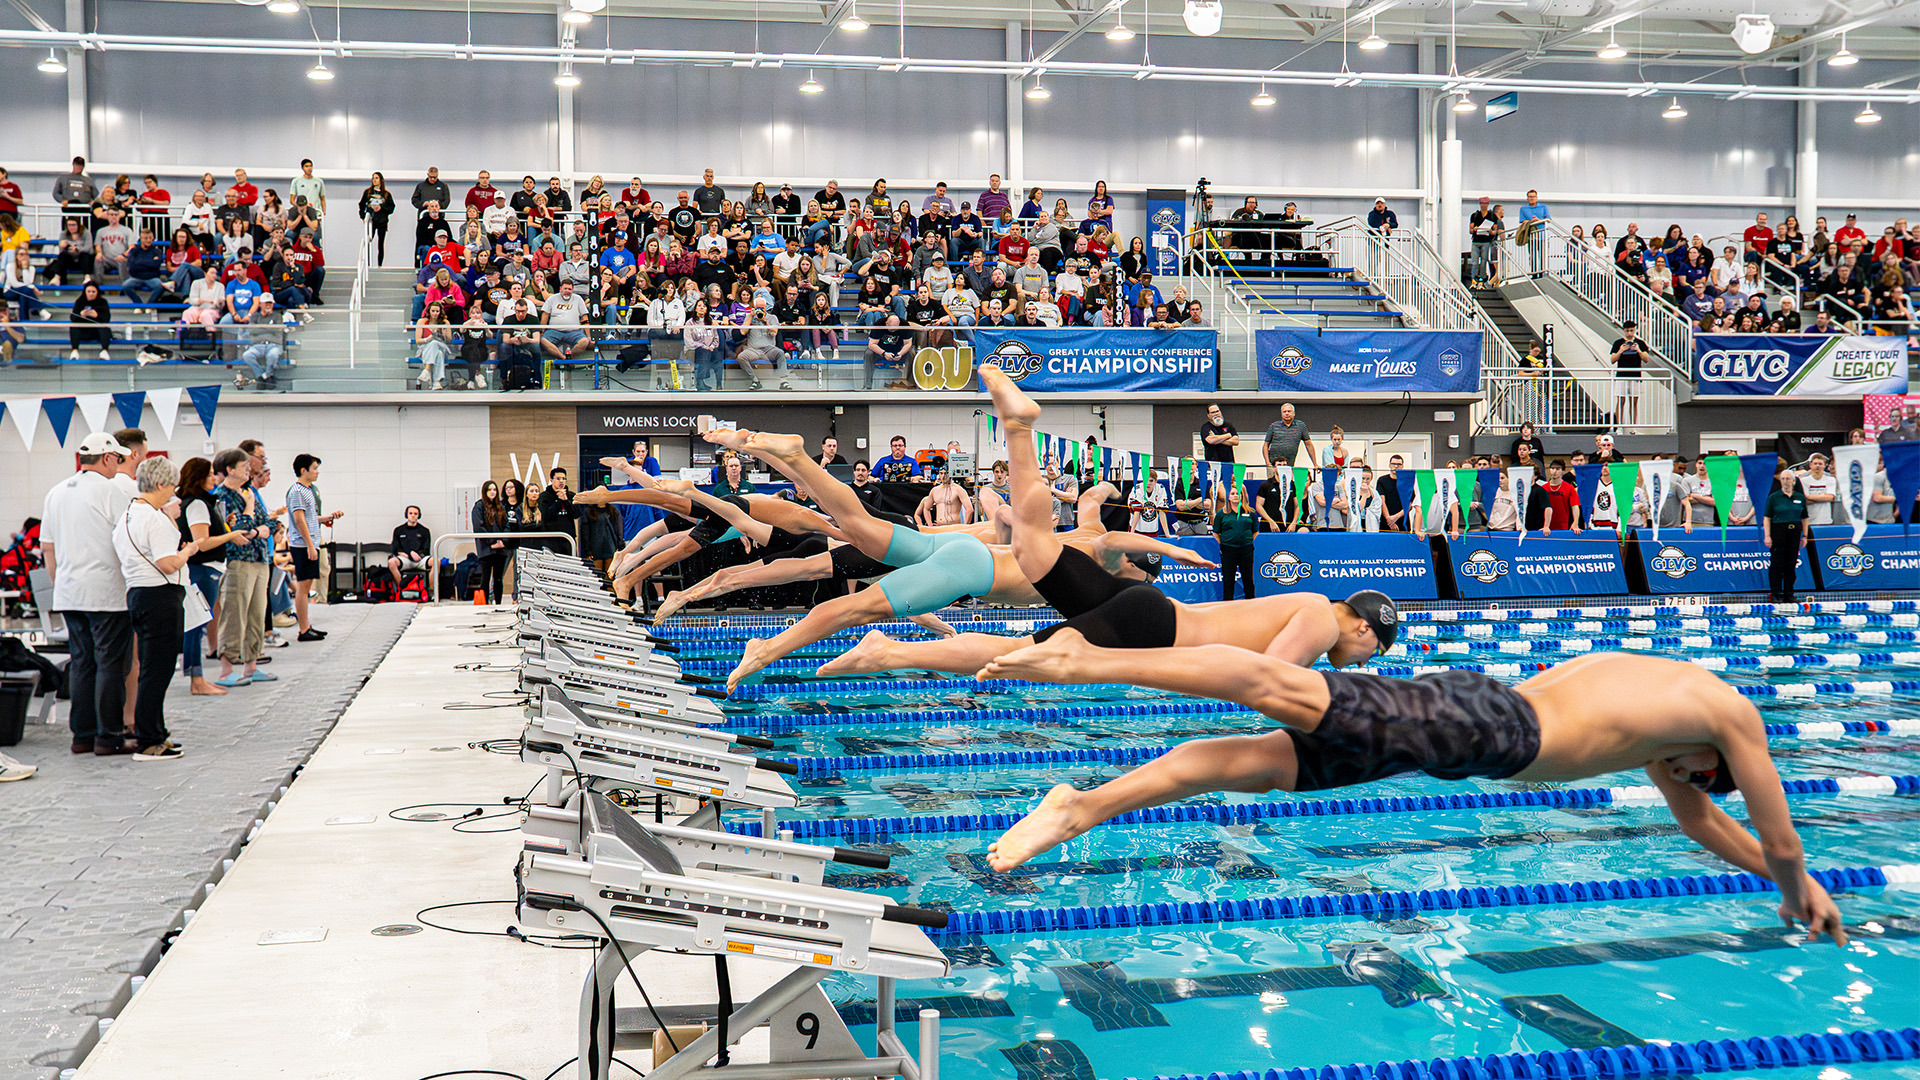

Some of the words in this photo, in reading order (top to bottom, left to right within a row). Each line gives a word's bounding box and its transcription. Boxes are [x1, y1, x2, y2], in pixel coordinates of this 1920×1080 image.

[1048, 348, 1080, 356] GREAT
[1082, 348, 1111, 356] LAKES
[1113, 348, 1149, 356] VALLEY
[1151, 348, 1212, 356] CONFERENCE
[1836, 350, 1872, 360] CREATE
[1874, 350, 1900, 360] YOUR
[913, 346, 973, 391] QU
[984, 354, 1043, 373] GLVC
[1047, 357, 1213, 374] CHAMPIONSHIP
[1271, 355, 1312, 370] GLVC
[1329, 363, 1360, 373] MAKE
[1362, 363, 1373, 373] IT
[1699, 349, 1790, 382] GLVC
[1832, 361, 1897, 379] LEGACY
[603, 416, 660, 427] WOMENS
[663, 416, 697, 427] LOCK
[1800, 436, 1825, 444] DRURY
[509, 453, 561, 491] W
[1461, 560, 1509, 577] GLVC
[1516, 561, 1616, 575] CHAMPIONSHIP
[1651, 556, 1698, 572] GLVC
[1827, 553, 1875, 570] GLVC
[1881, 558, 1920, 569] CHAM
[1260, 562, 1312, 578] GLVC
[1319, 567, 1427, 579] CHAMPIONSHIP
[1669, 597, 1674, 606] 7
[1677, 597, 1687, 606] FT
[1690, 596, 1696, 605] 6
[796, 1012, 820, 1050] 9
